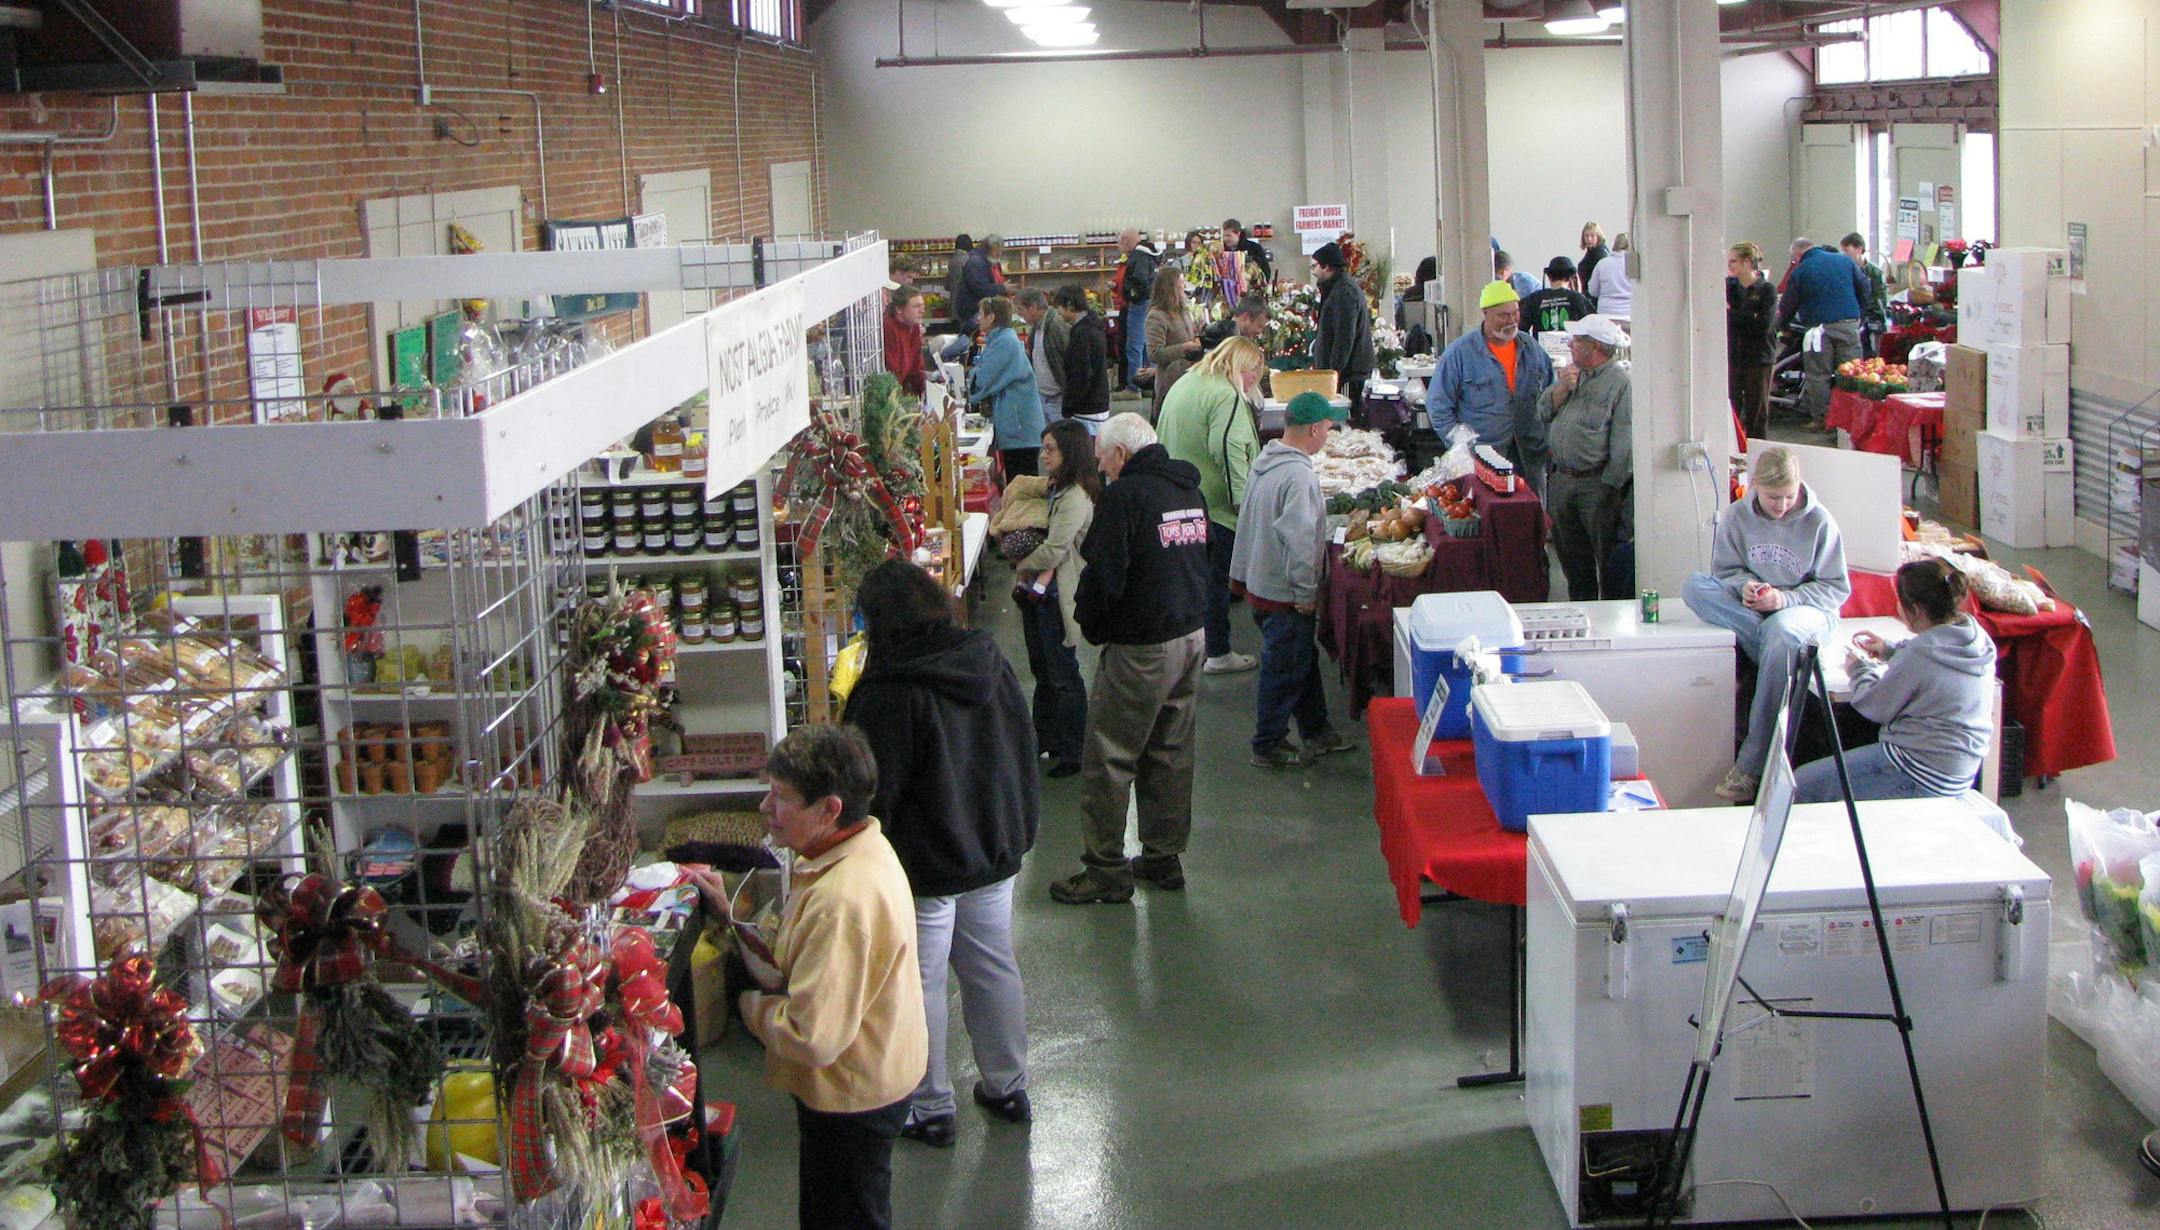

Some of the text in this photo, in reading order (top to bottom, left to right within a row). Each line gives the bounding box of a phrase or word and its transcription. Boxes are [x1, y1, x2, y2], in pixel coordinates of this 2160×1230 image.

[1298, 206, 1342, 218] FREIGHT HOUSE
[1295, 218, 1345, 230] FARMERS MARKET
[1161, 523, 1180, 540] TOYS
[1183, 523, 1195, 538] FOR
